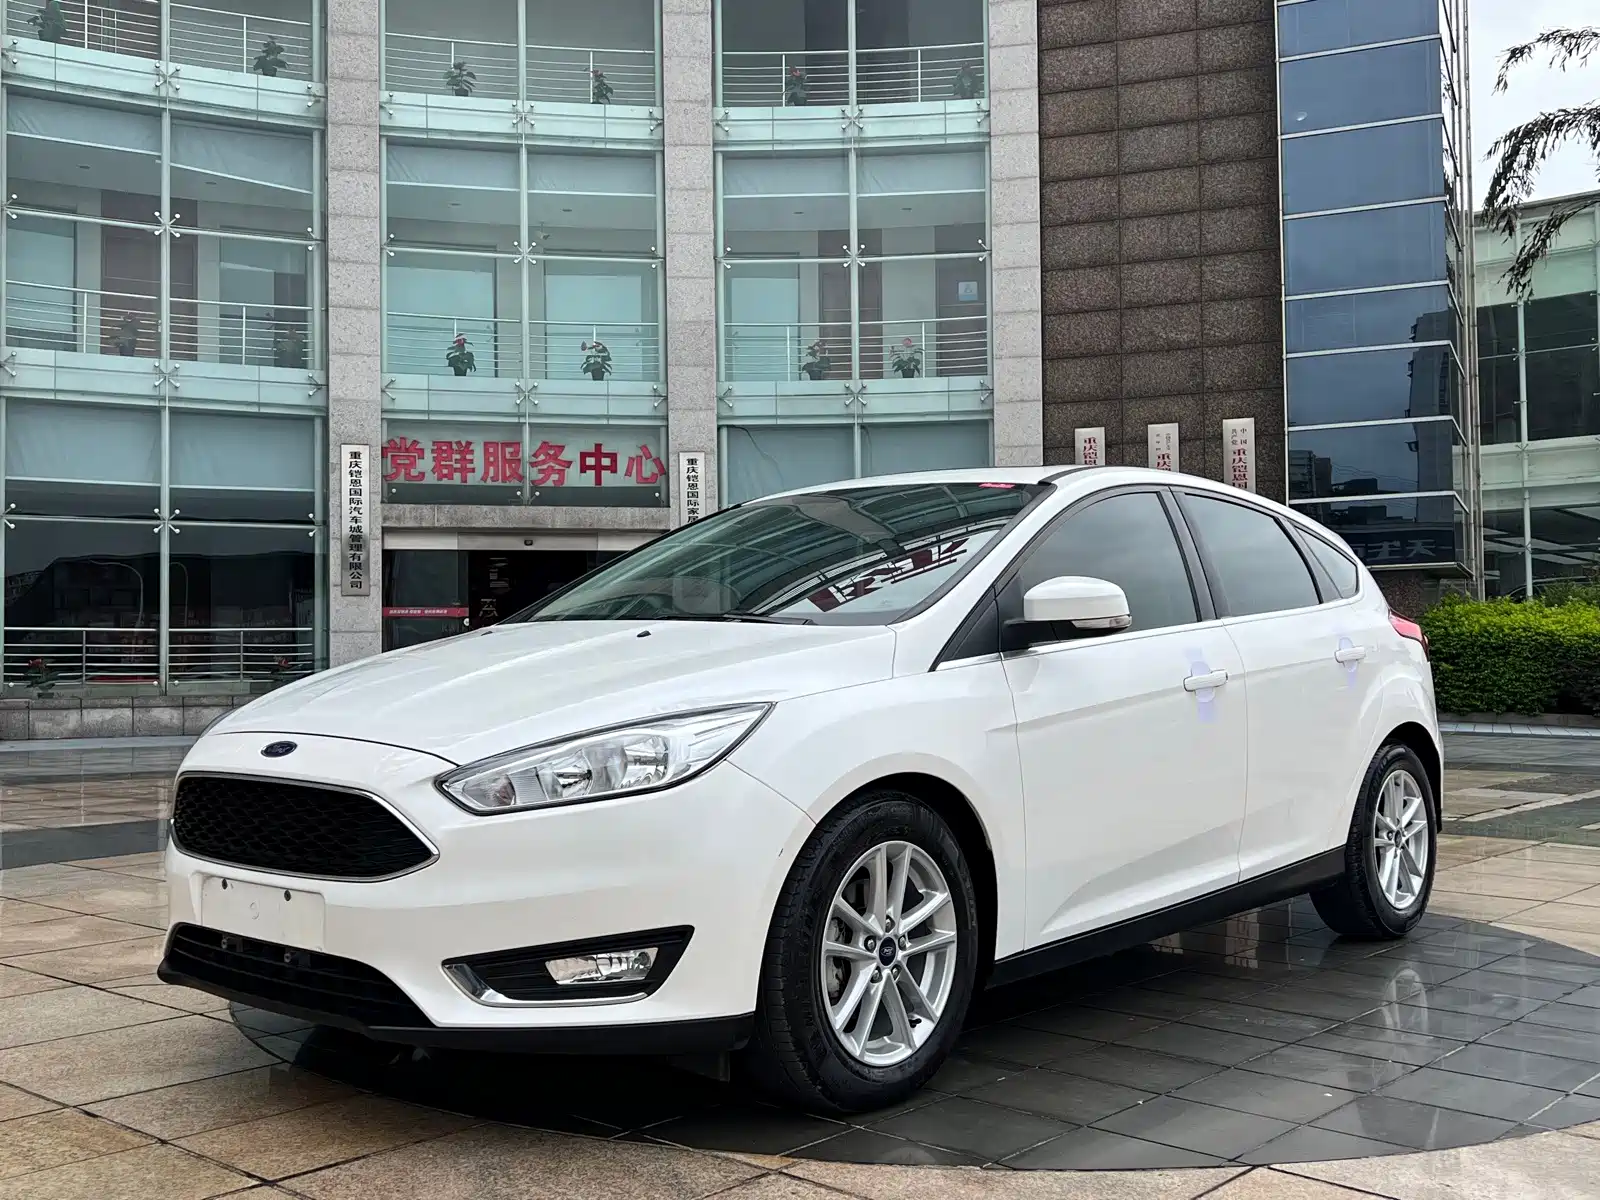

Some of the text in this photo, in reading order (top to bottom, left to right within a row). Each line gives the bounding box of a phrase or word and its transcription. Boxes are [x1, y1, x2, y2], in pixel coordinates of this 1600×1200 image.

[382, 436, 667, 487] 党群服务中心
[348, 450, 363, 590] 重庆铠恩国际汽车城管理有限公司
